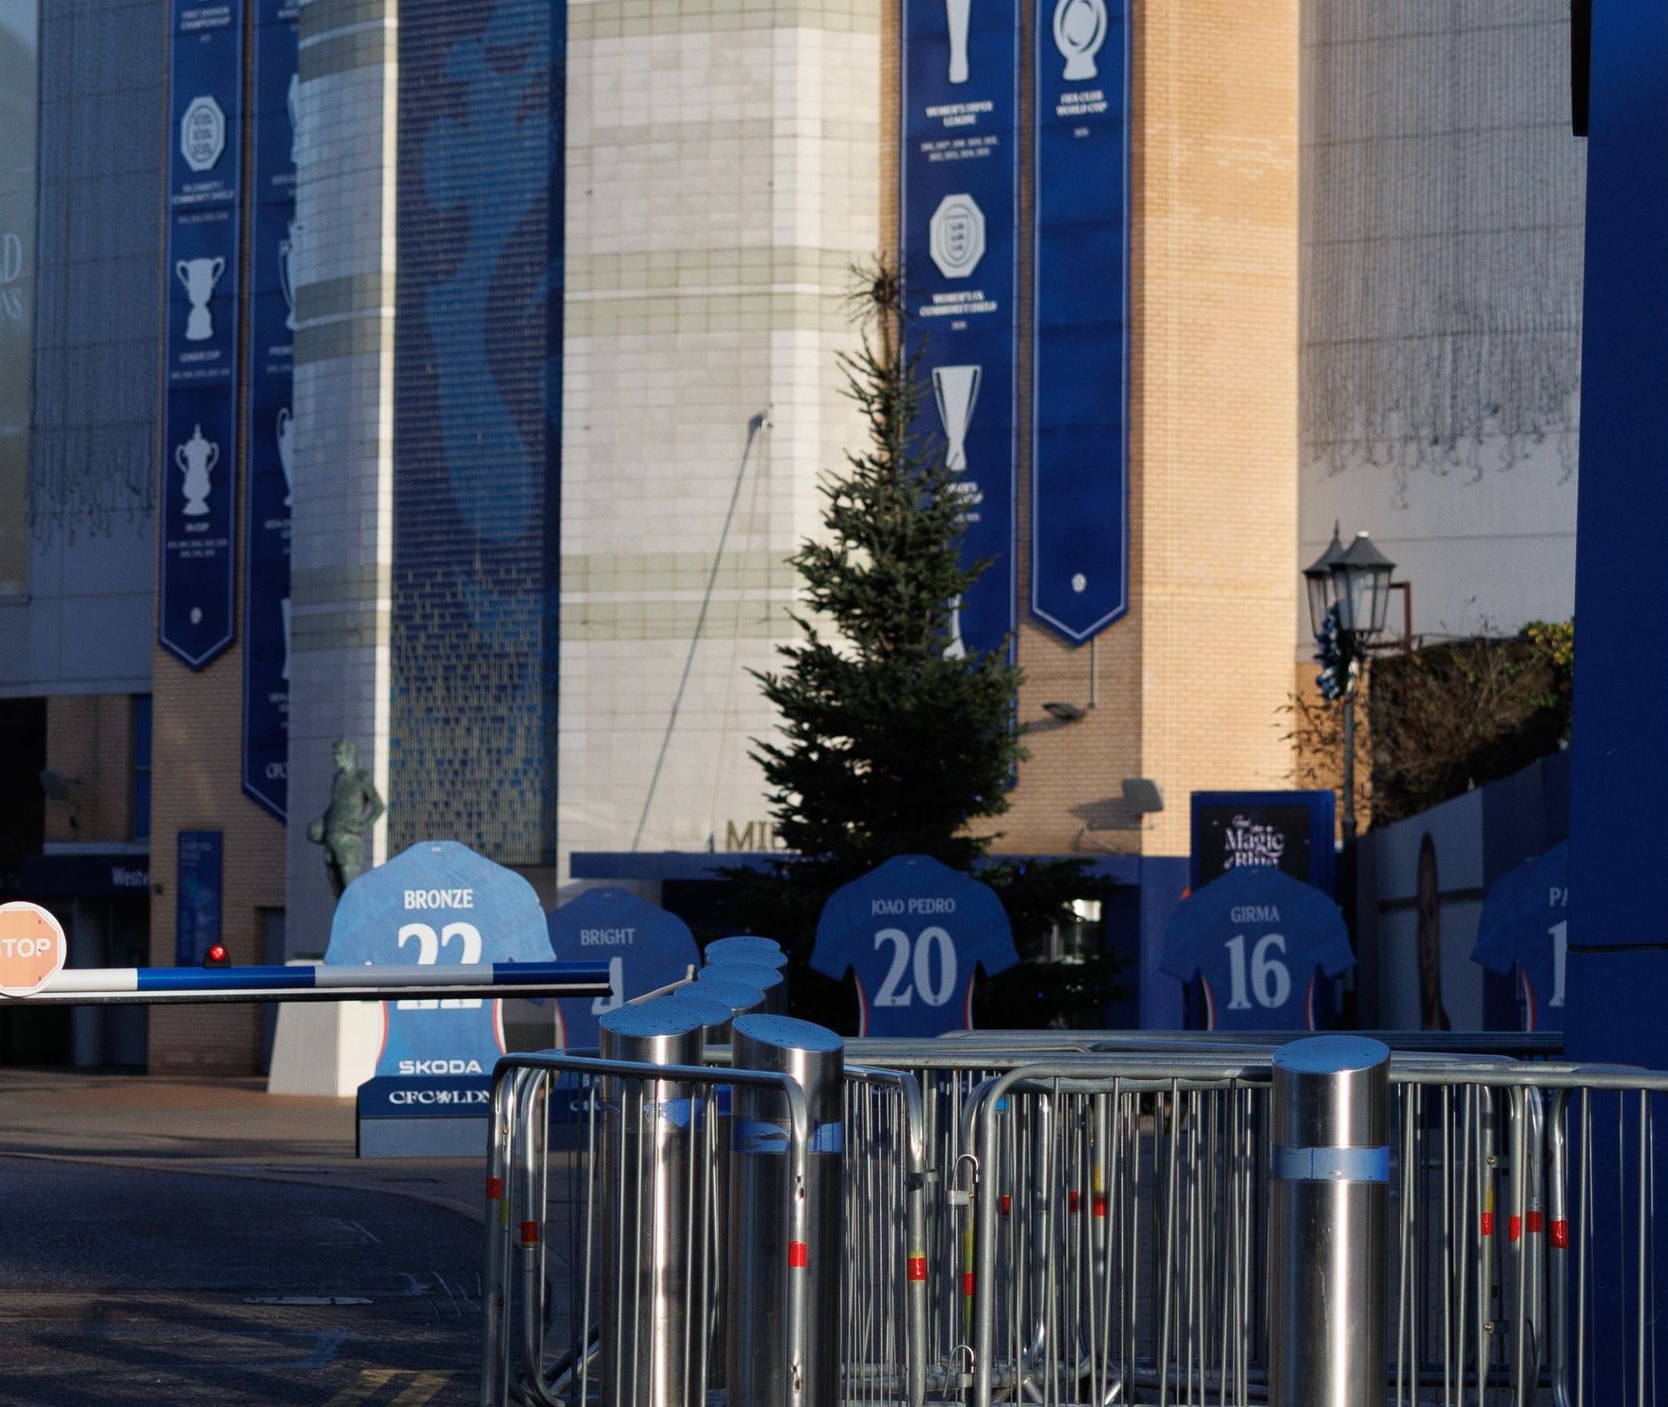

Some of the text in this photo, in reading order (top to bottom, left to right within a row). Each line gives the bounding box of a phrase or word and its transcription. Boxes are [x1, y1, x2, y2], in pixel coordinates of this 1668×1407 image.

[1225, 825, 1285, 858] Magic
[404, 888, 475, 910] BRONZE
[908, 897, 956, 914] PEDRO
[1230, 905, 1281, 923] GIRMA
[580, 928, 636, 946] BRIGHT
[873, 926, 959, 1007] 20
[1224, 933, 1292, 1010] 16
[398, 1059, 484, 1075] SKODA
